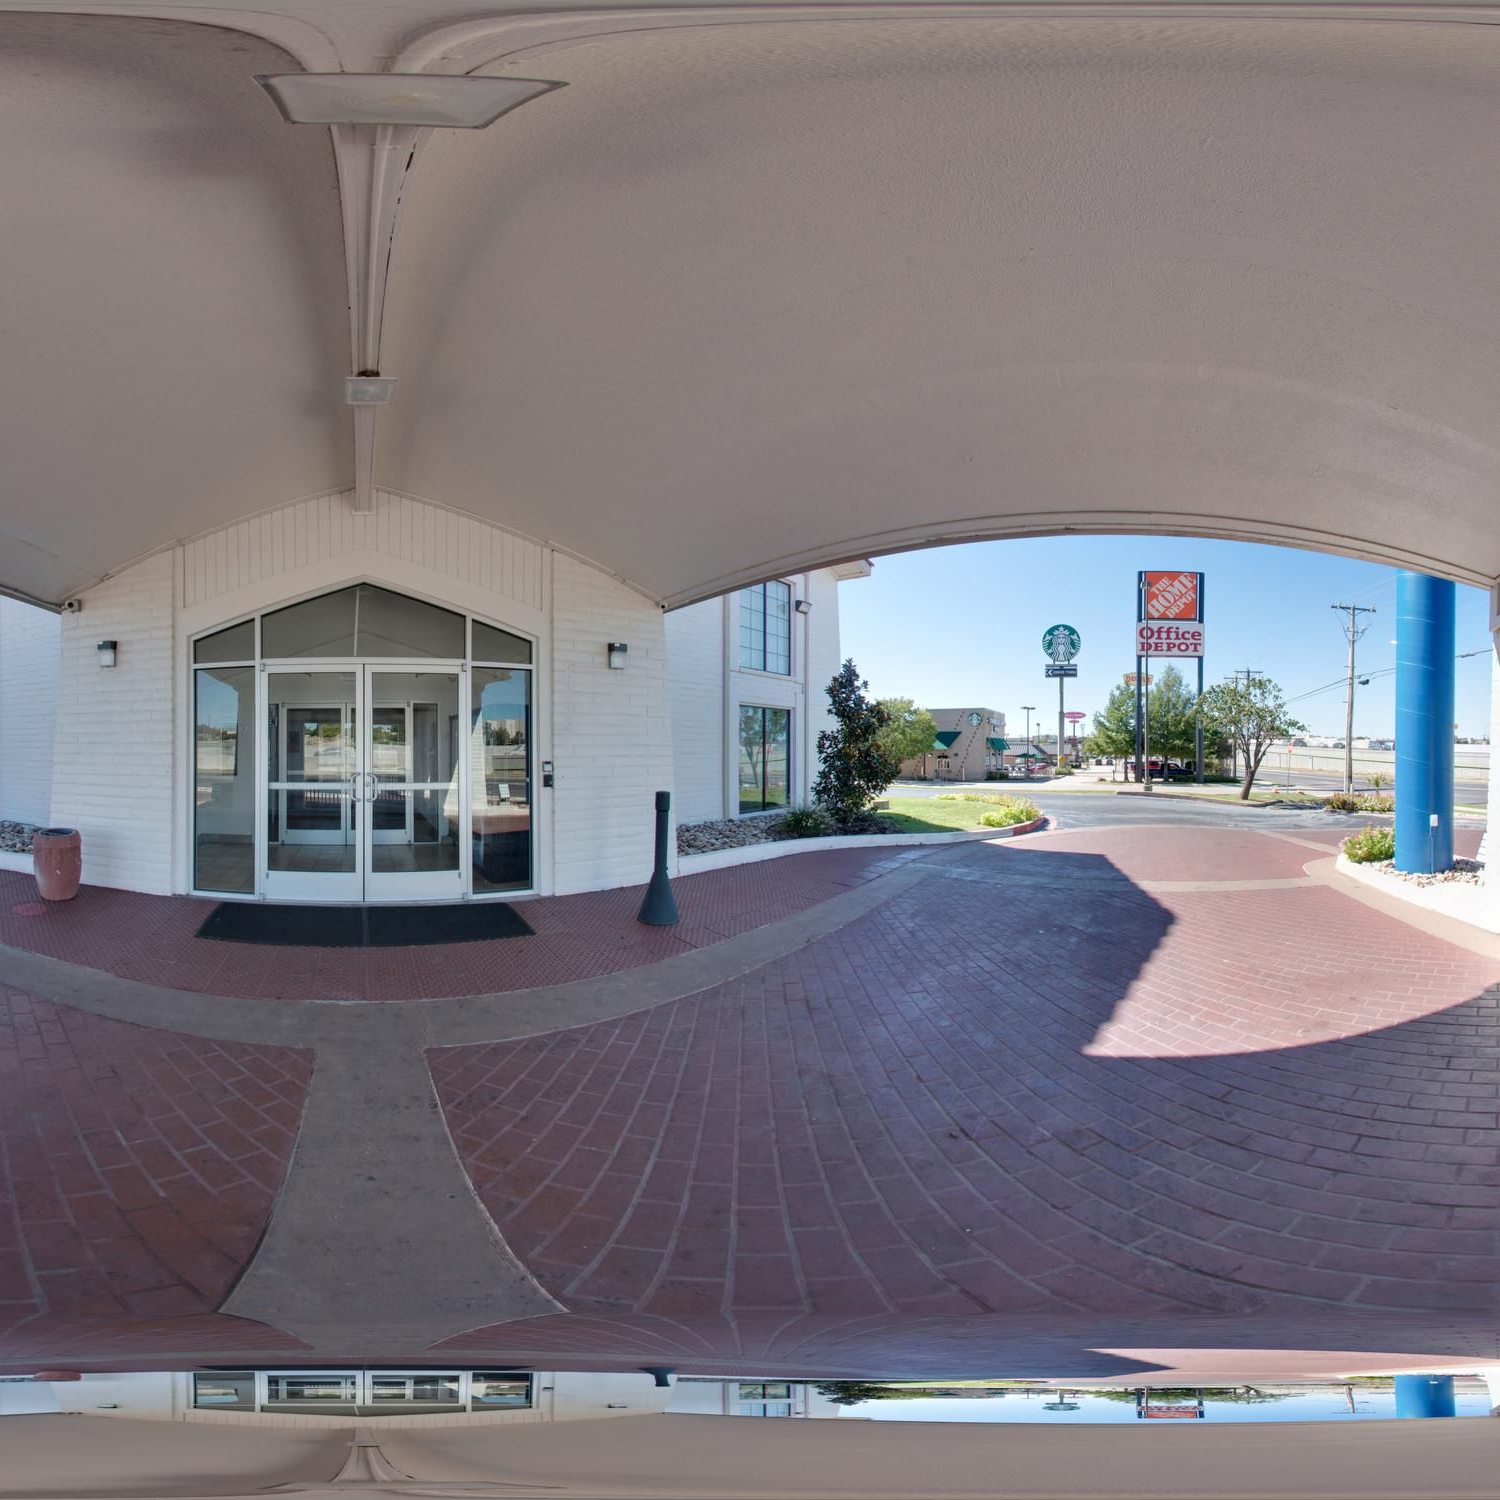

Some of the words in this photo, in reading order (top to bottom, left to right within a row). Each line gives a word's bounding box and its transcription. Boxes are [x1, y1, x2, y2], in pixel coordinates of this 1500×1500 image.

[1150, 576, 1171, 594] THE
[1147, 573, 1196, 617] HOME
[1165, 589, 1196, 617] DEPOT
[1139, 626, 1202, 640] Office
[1140, 641, 1202, 652] DEPOT
